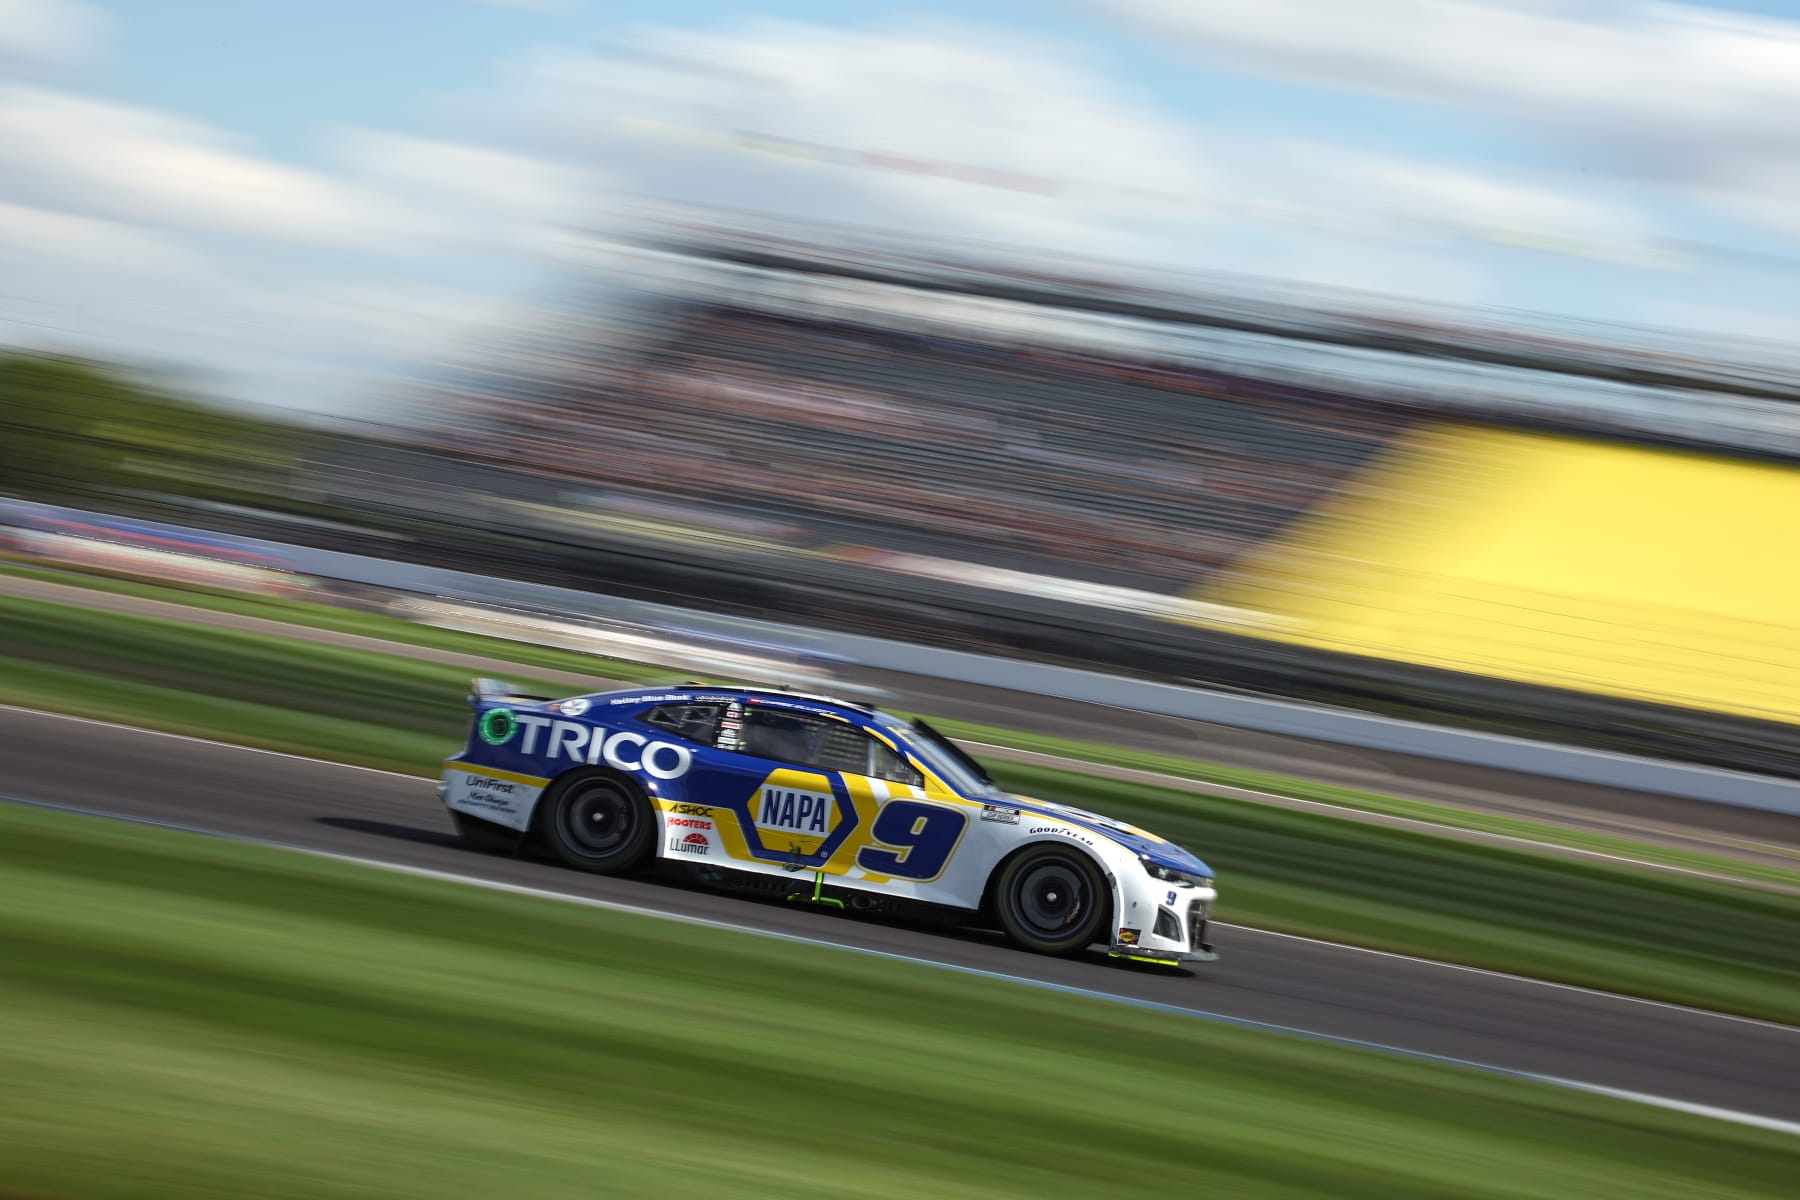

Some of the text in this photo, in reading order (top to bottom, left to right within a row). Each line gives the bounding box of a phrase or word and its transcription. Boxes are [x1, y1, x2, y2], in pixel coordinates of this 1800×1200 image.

[515, 714, 693, 780] TRICO
[465, 775, 515, 793] UniFirst
[761, 789, 826, 833] NAPA
[856, 797, 969, 884] 9
[1029, 827, 1093, 846] GOODYEAR
[1165, 890, 1177, 907] 9
